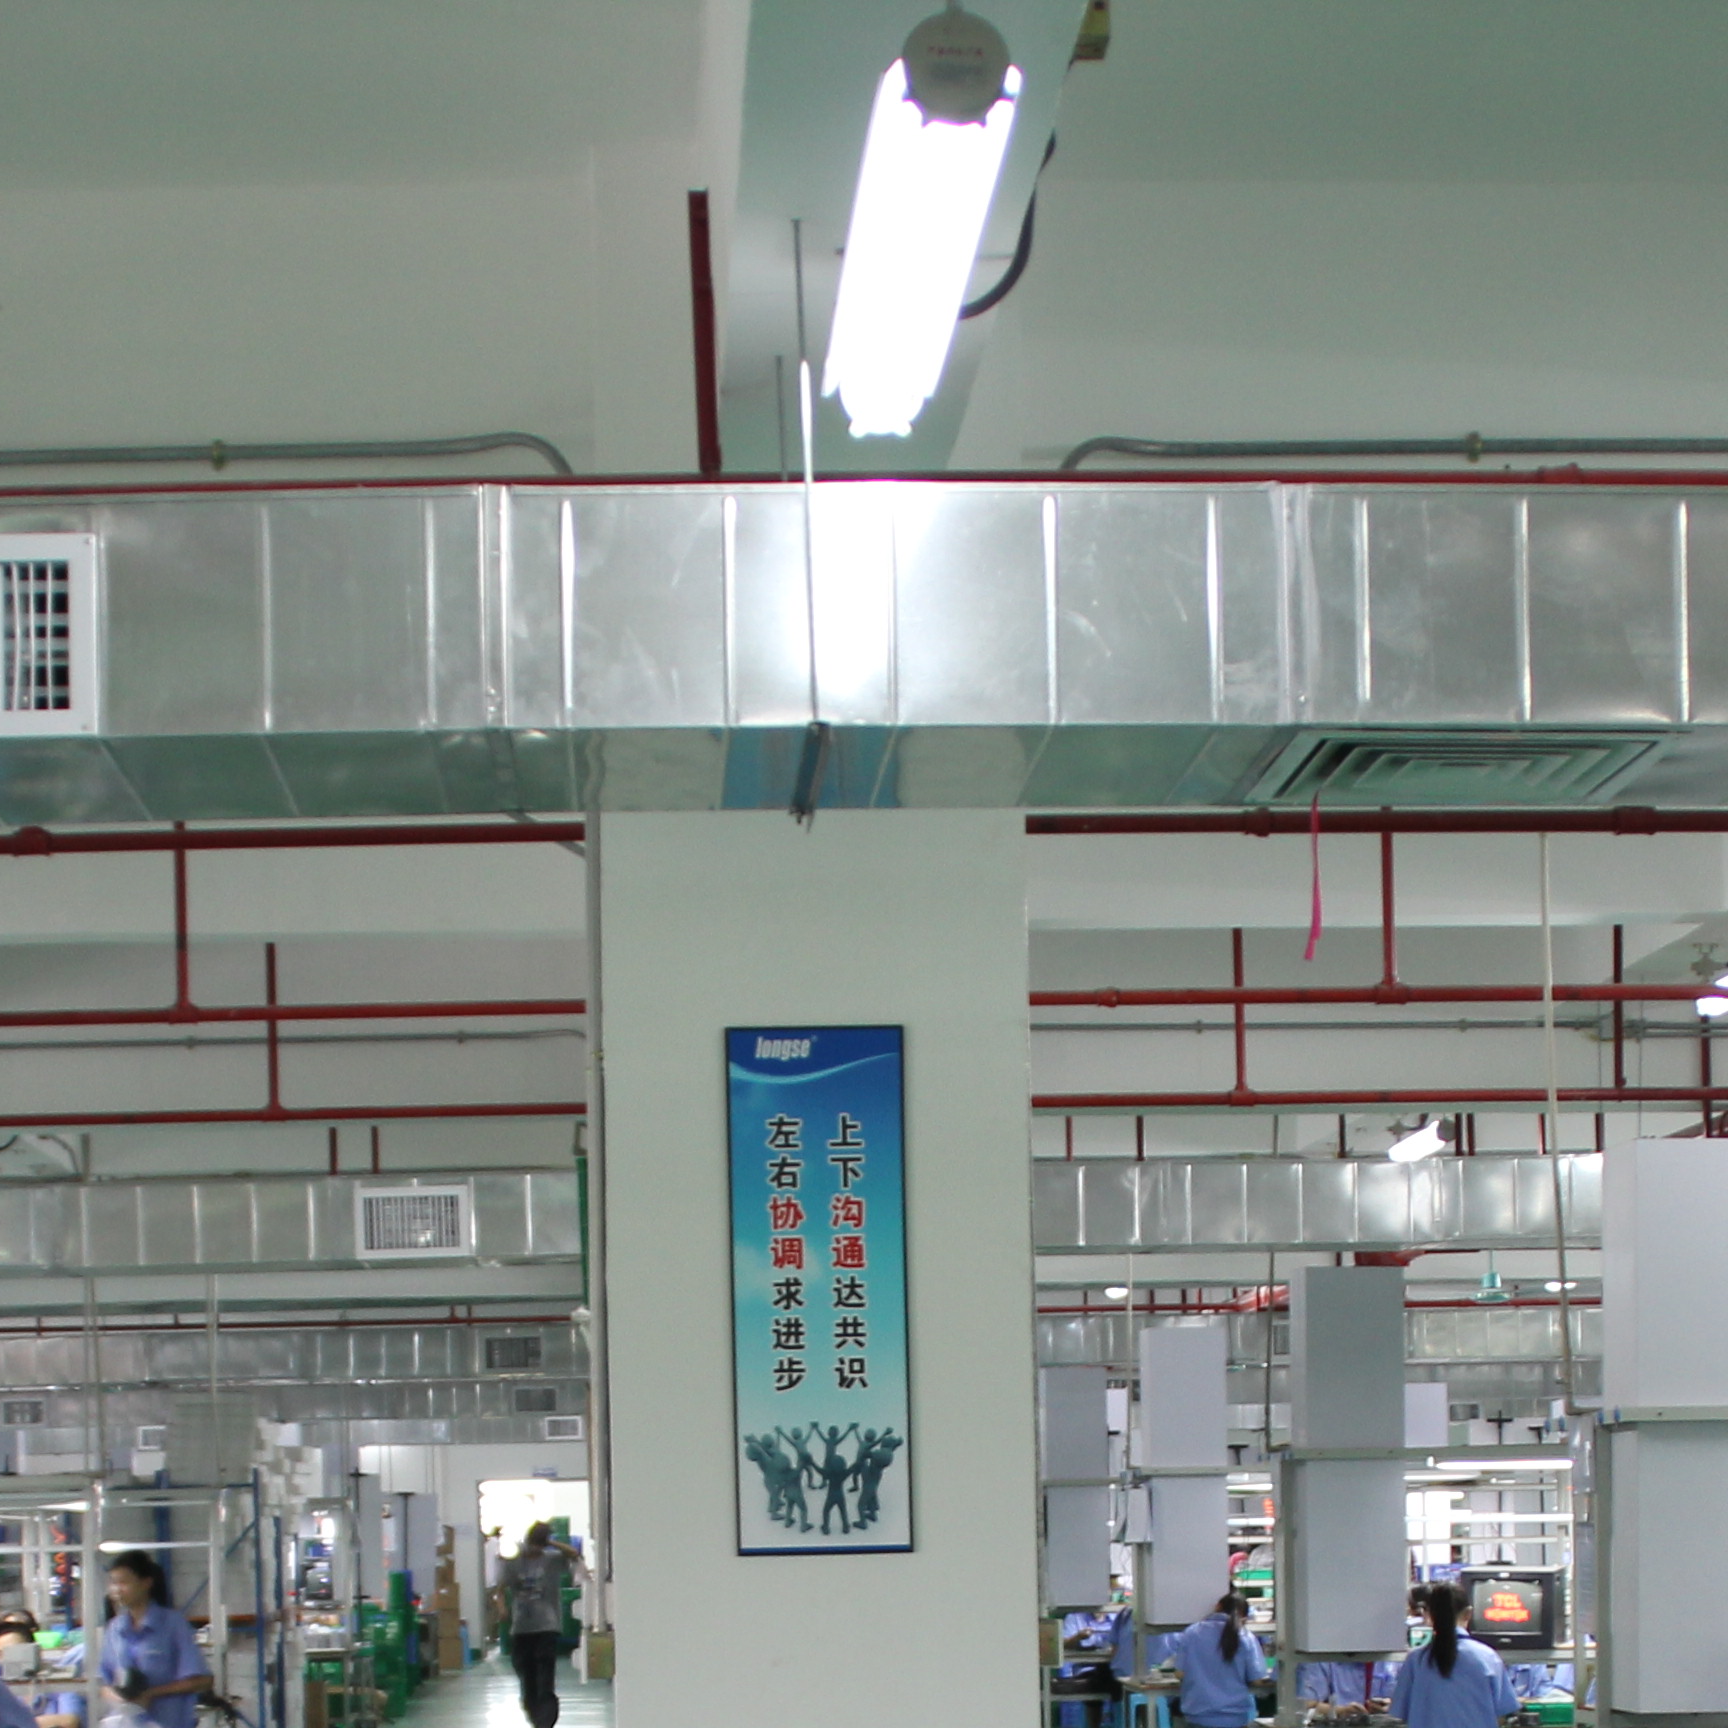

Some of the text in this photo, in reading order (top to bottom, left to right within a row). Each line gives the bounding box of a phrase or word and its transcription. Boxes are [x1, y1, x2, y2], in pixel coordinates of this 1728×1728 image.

[755, 1036, 811, 1061] longse
[767, 1114, 806, 1392] 左右协调求进步
[828, 1114, 868, 1391] 上下沟通达共识
